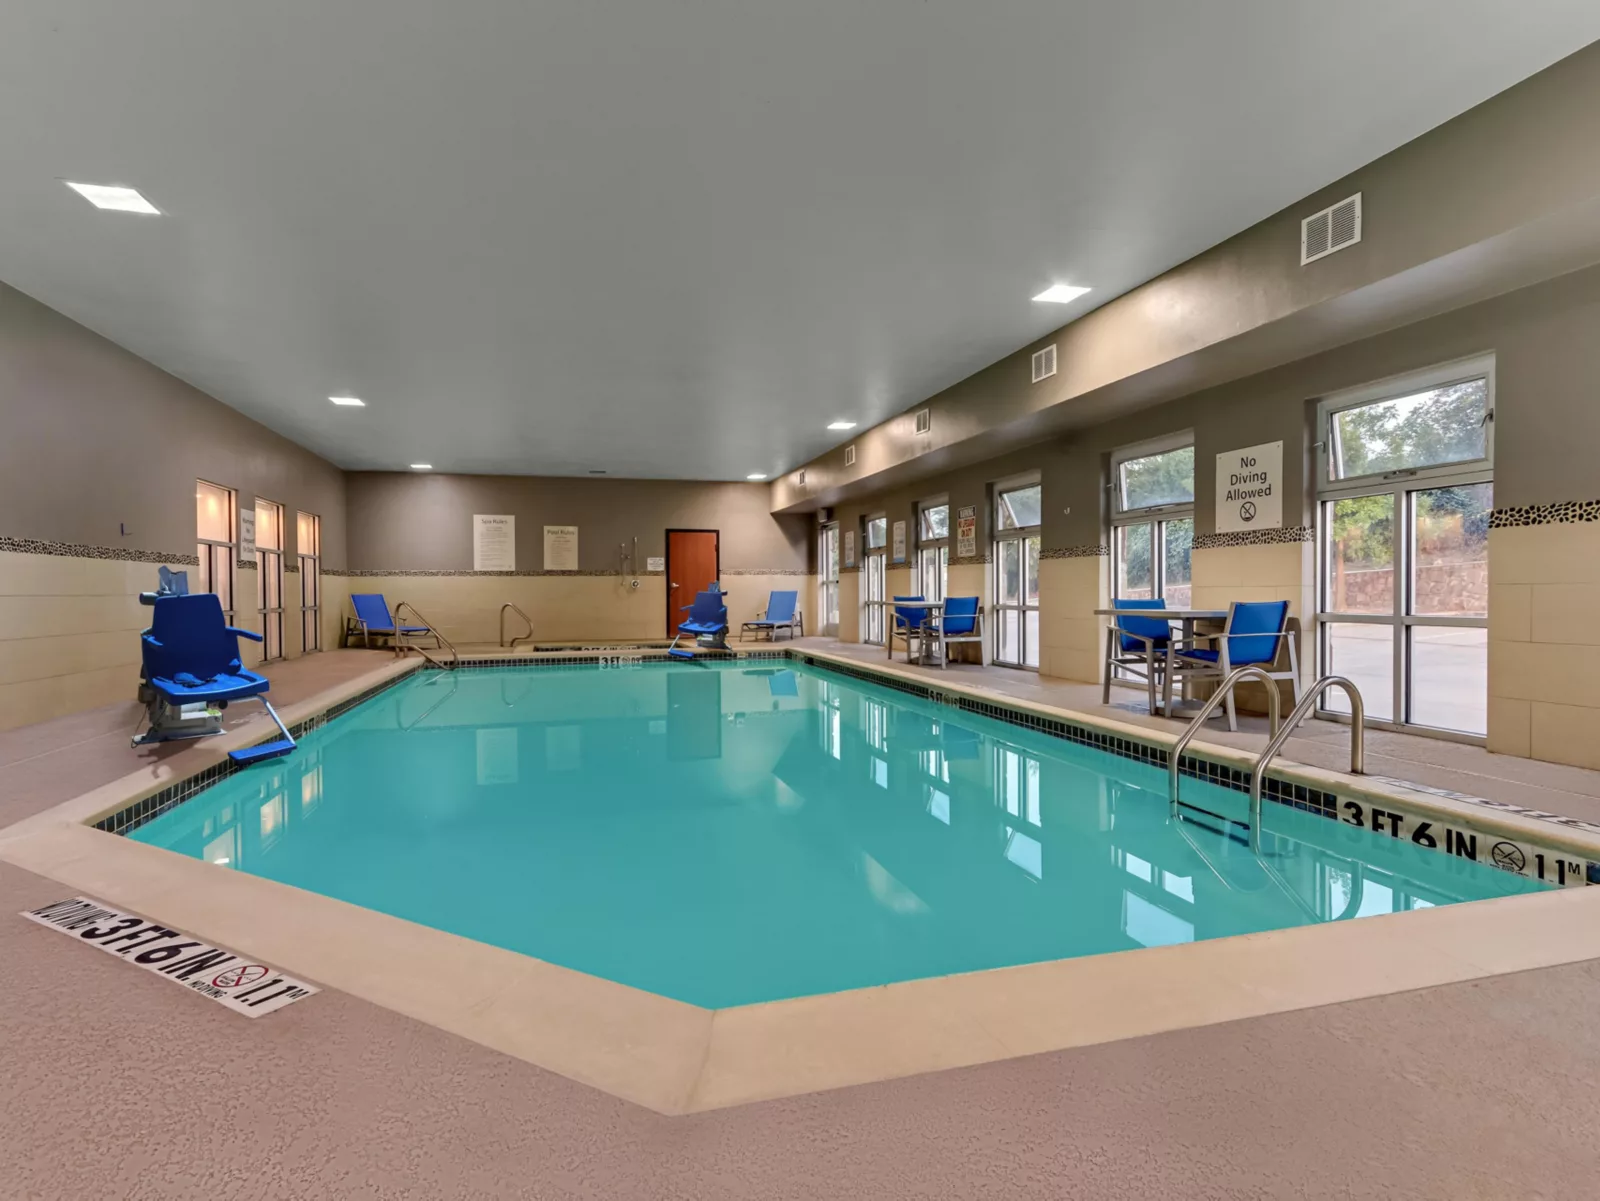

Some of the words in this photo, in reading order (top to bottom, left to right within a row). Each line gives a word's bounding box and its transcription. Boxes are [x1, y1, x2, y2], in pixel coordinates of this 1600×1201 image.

[1241, 456, 1256, 468] No
[1230, 471, 1267, 486] Diving
[1226, 484, 1272, 501] Allowed
[1342, 801, 1365, 827] 3
[1411, 822, 1437, 848] 6
[80, 918, 144, 939] 3
[134, 942, 203, 964] 6
